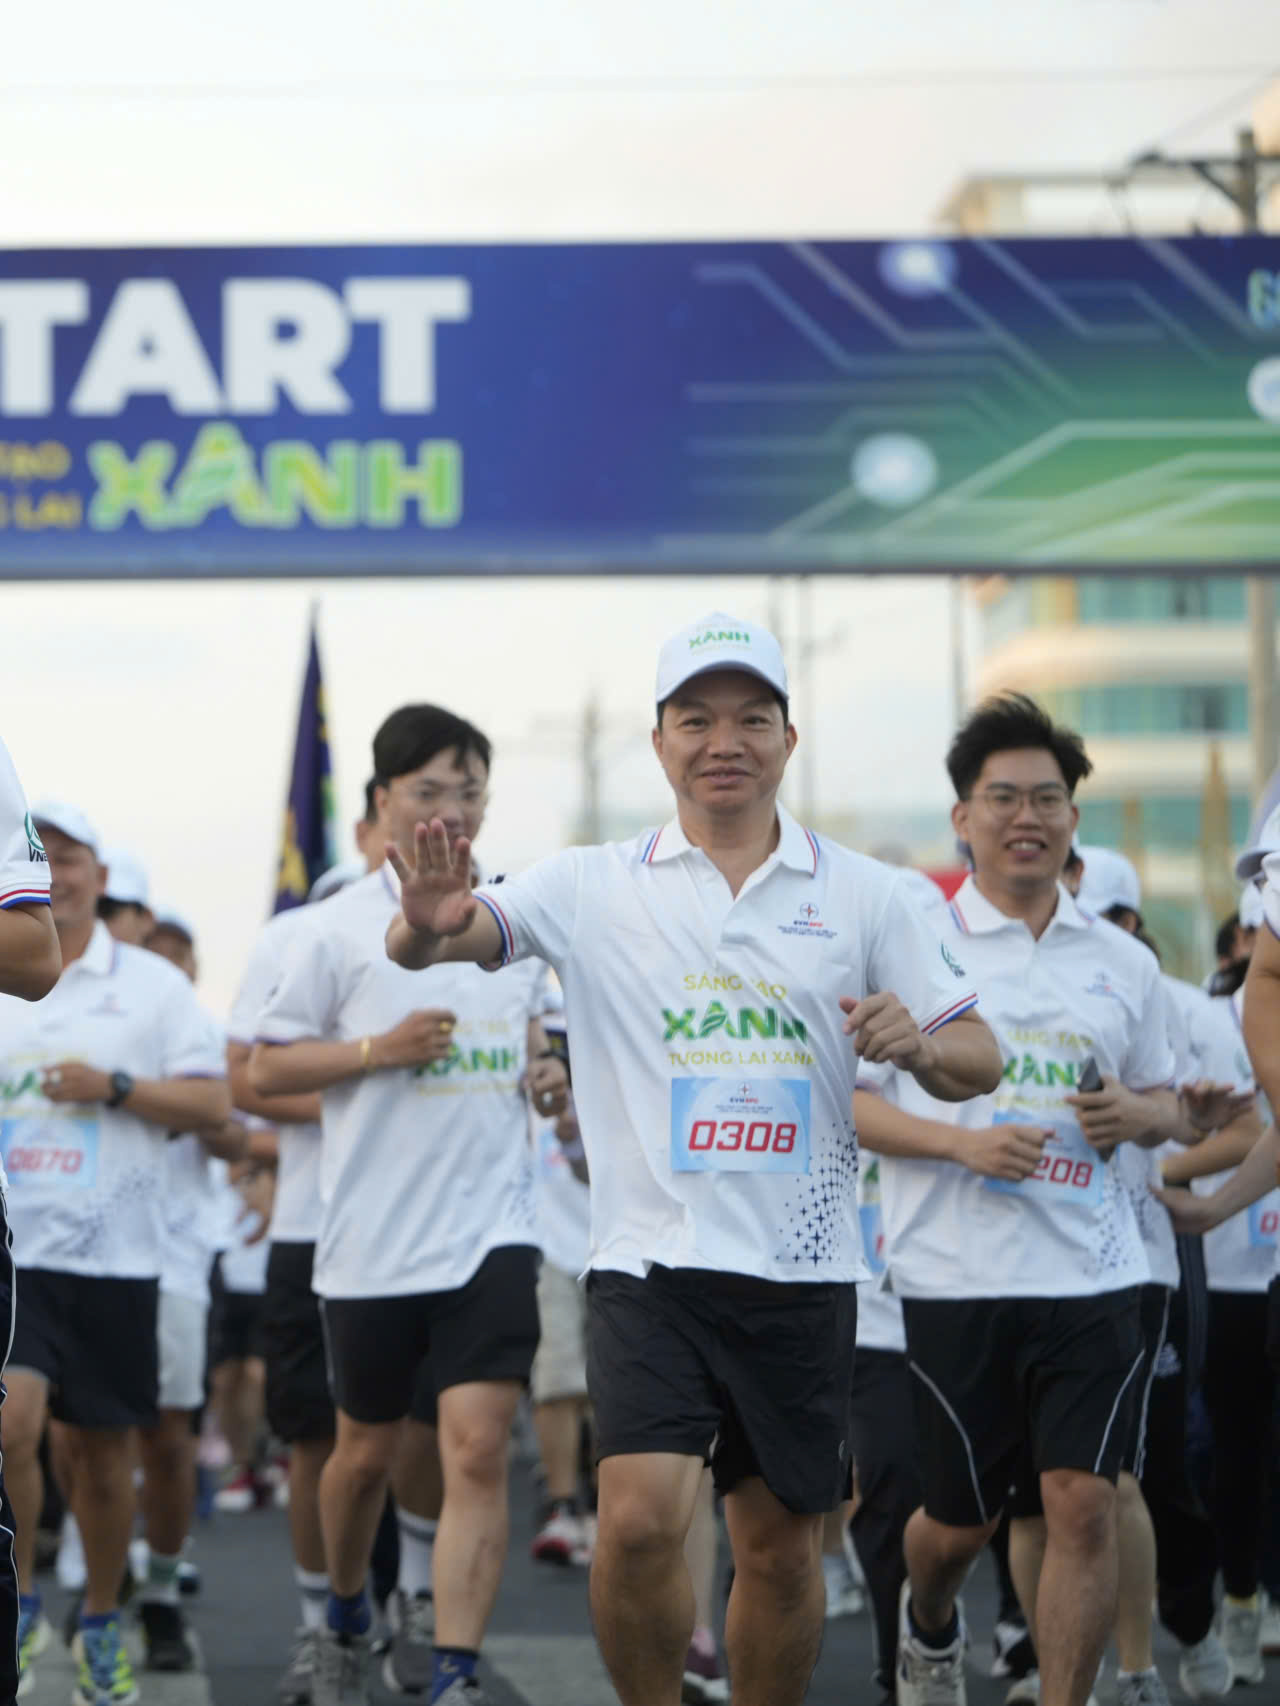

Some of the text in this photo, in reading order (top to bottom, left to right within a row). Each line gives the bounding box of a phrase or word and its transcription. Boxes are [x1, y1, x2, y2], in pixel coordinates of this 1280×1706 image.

[87, 422, 462, 531] XANH
[688, 629, 750, 650] XANH
[739, 1051, 768, 1066] LAI
[688, 1120, 798, 1153] 0308
[1030, 1156, 1094, 1189] 208
